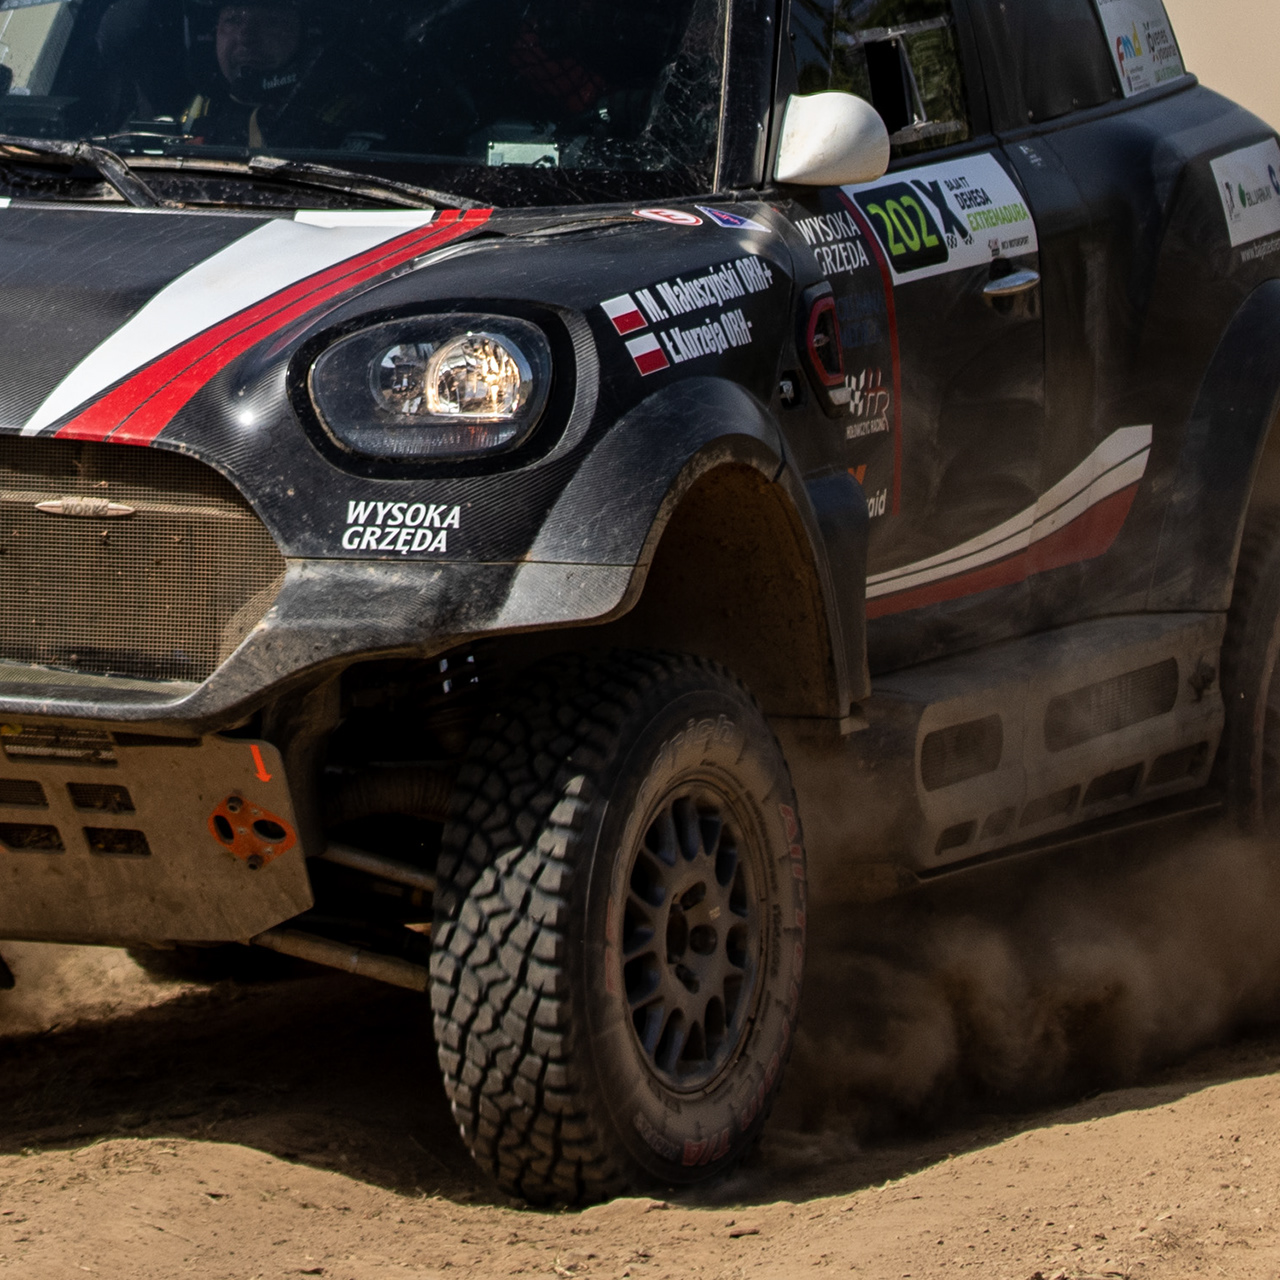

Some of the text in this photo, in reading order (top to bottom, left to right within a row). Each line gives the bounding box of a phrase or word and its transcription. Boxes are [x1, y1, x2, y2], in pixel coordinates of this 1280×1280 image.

[944, 182, 960, 192] BAJA
[954, 188, 993, 211] DEHESA
[794, 210, 861, 247] WYSOKA
[866, 195, 940, 257] 202
[966, 203, 1031, 233] EXTREMADURA
[635, 289, 669, 323] M.
[735, 255, 773, 294] ORH+
[62, 502, 109, 516] WORKS
[346, 500, 461, 529] WYSOKA
[866, 488, 888, 519] aid
[341, 525, 448, 555] GRZĘDA
